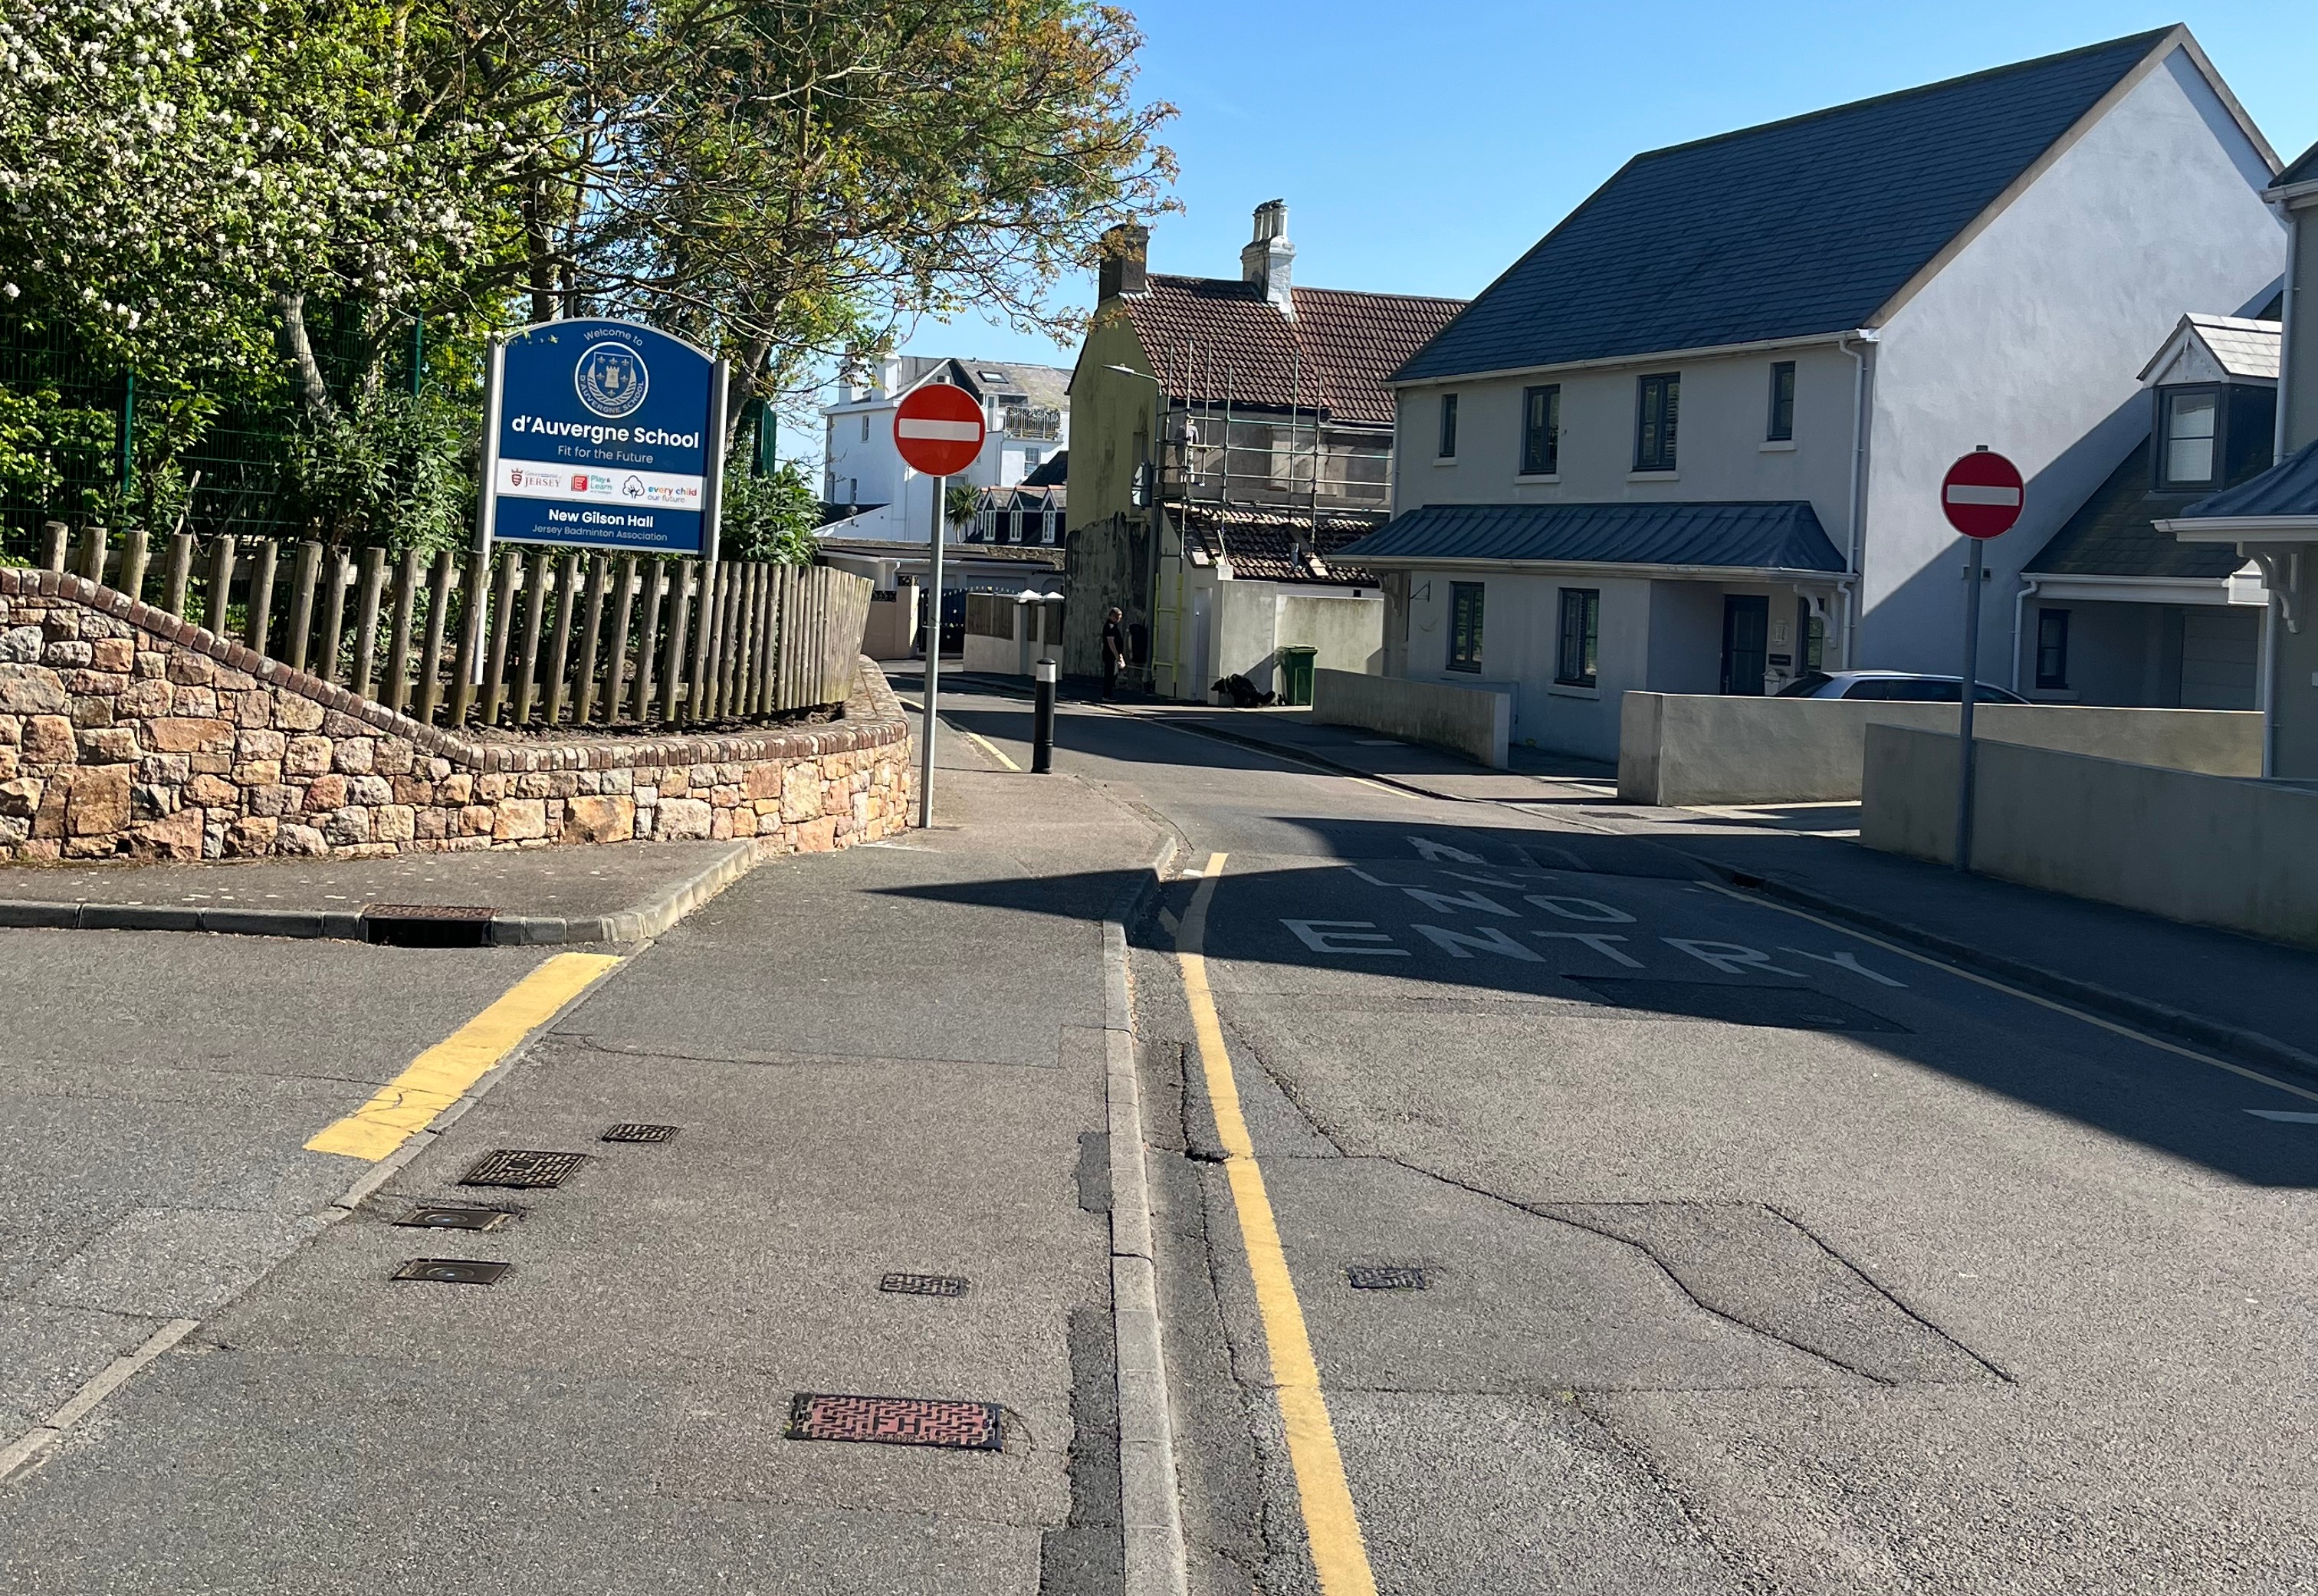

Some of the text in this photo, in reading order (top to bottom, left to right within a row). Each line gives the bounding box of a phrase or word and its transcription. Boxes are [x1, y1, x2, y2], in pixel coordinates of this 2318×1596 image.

[583, 328, 643, 346] Welcome to
[622, 381, 645, 411] SCHOOL
[634, 427, 699, 448] School
[558, 445, 653, 464] Fit for the Future
[524, 476, 561, 488] JERSEY
[590, 475, 606, 484] Play
[590, 482, 612, 491] Learn
[648, 486, 697, 497] every child
[662, 494, 685, 504] future
[549, 508, 654, 528] New Gilson Hall
[533, 524, 668, 542] Jersey Badminton Association
[1400, 887, 1637, 924] NO
[1279, 918, 1909, 989] ENTRY
